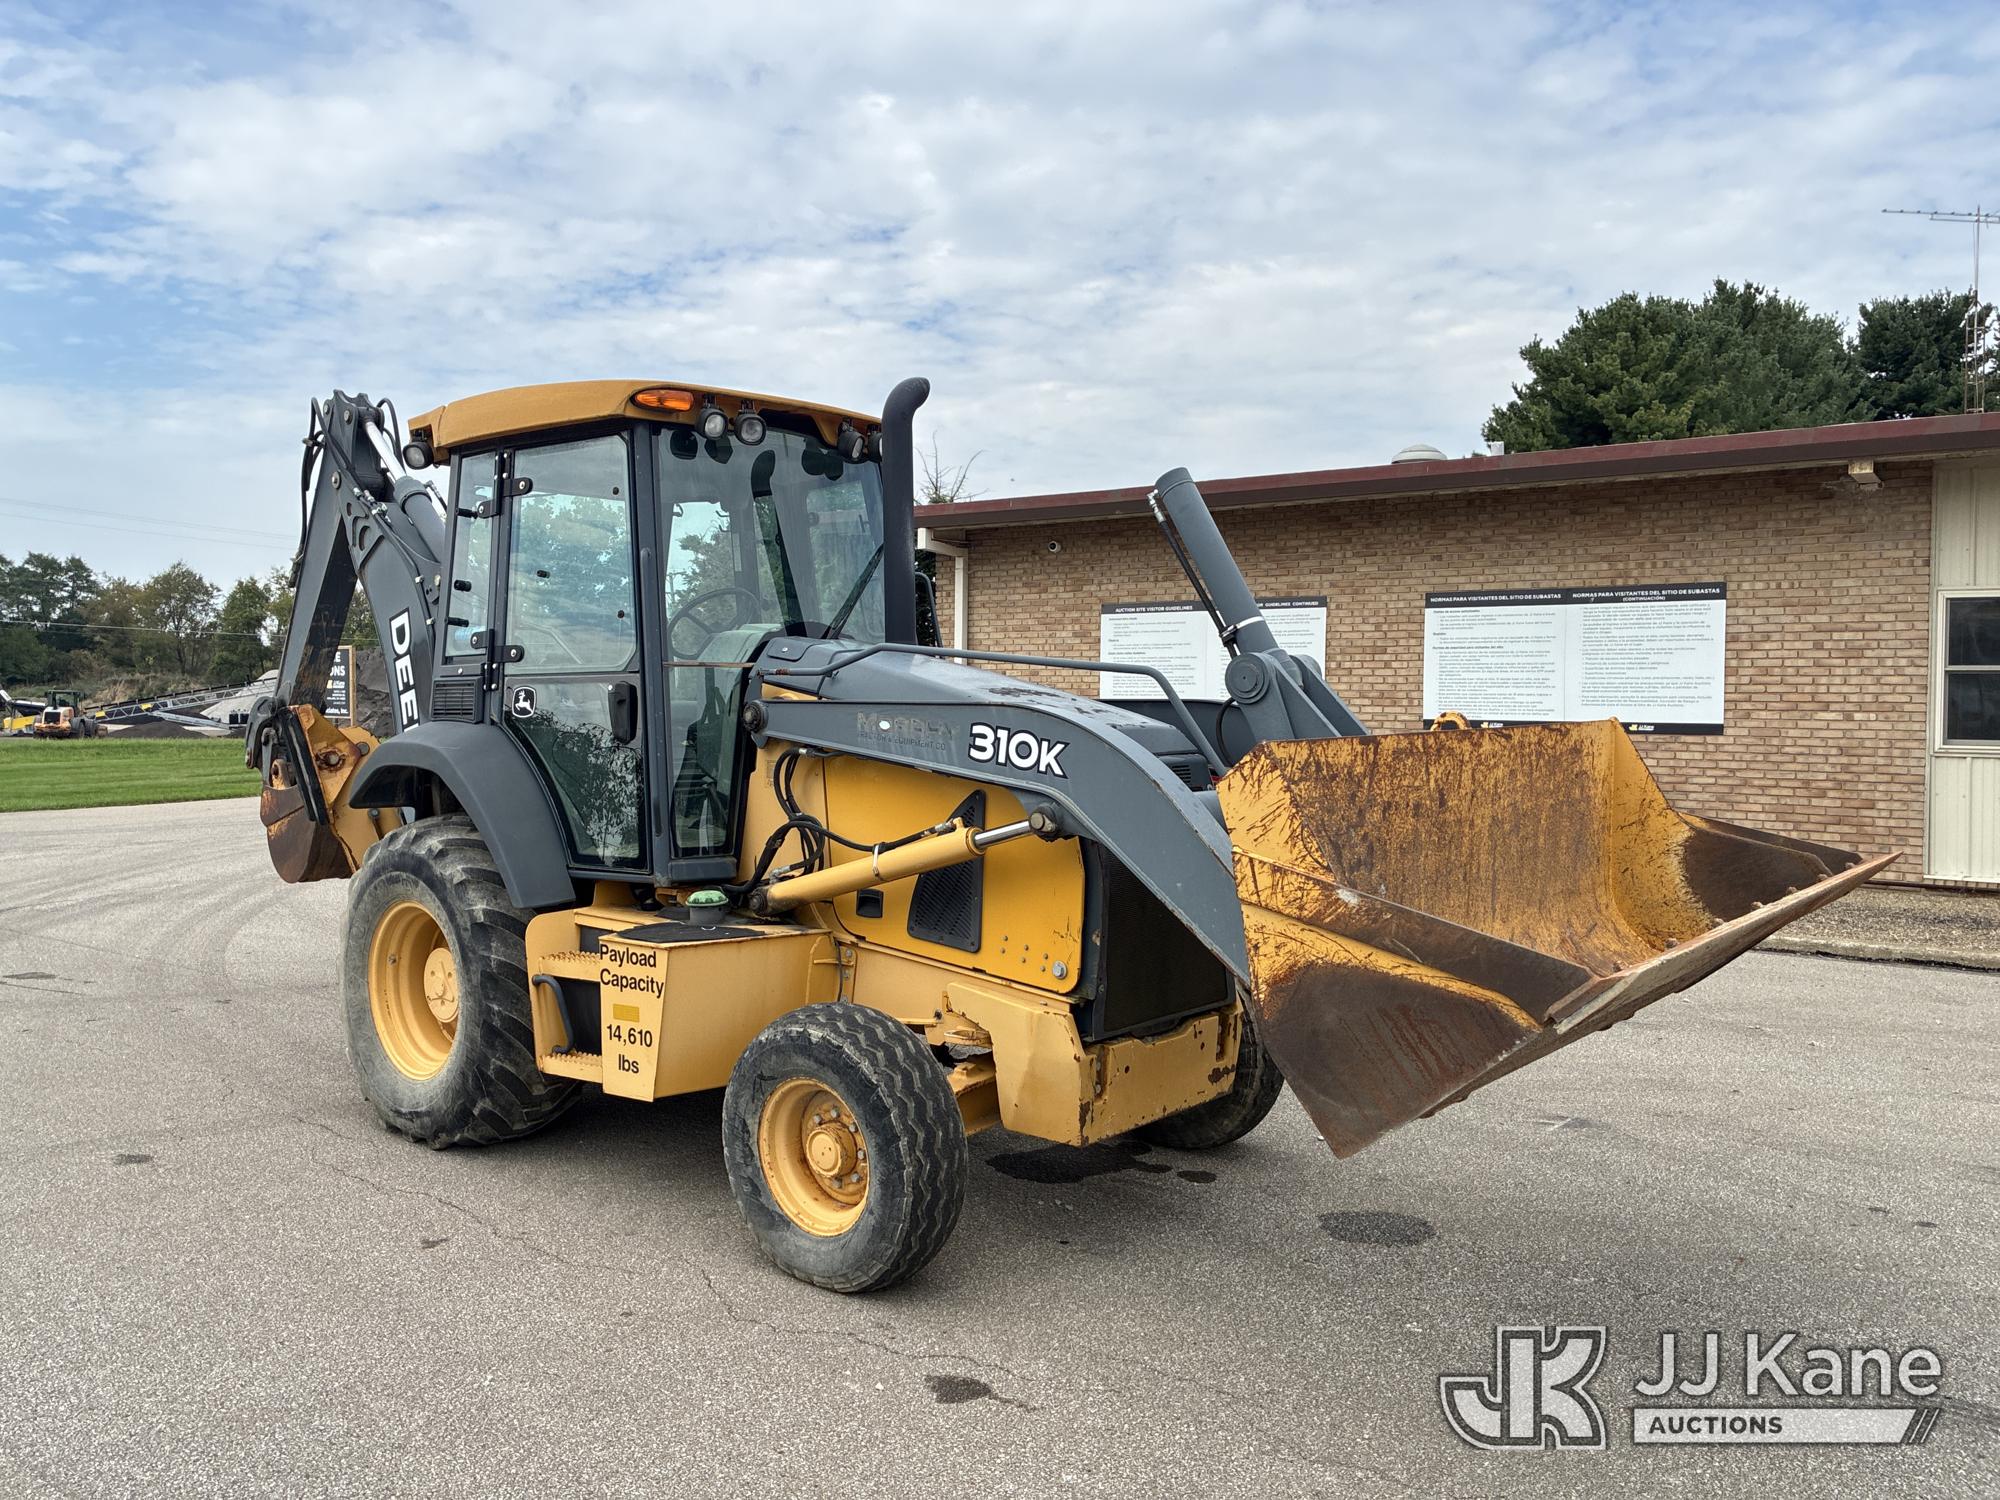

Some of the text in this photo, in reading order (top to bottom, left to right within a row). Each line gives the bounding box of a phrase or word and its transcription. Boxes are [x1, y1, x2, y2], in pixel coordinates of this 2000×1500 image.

[389, 608, 420, 732] DEE
[968, 722, 1071, 779] 310K
[600, 944, 657, 968] Payload
[600, 968, 664, 998] Capacity
[607, 1024, 653, 1047] 14,610
[618, 1053, 639, 1073] lbs
